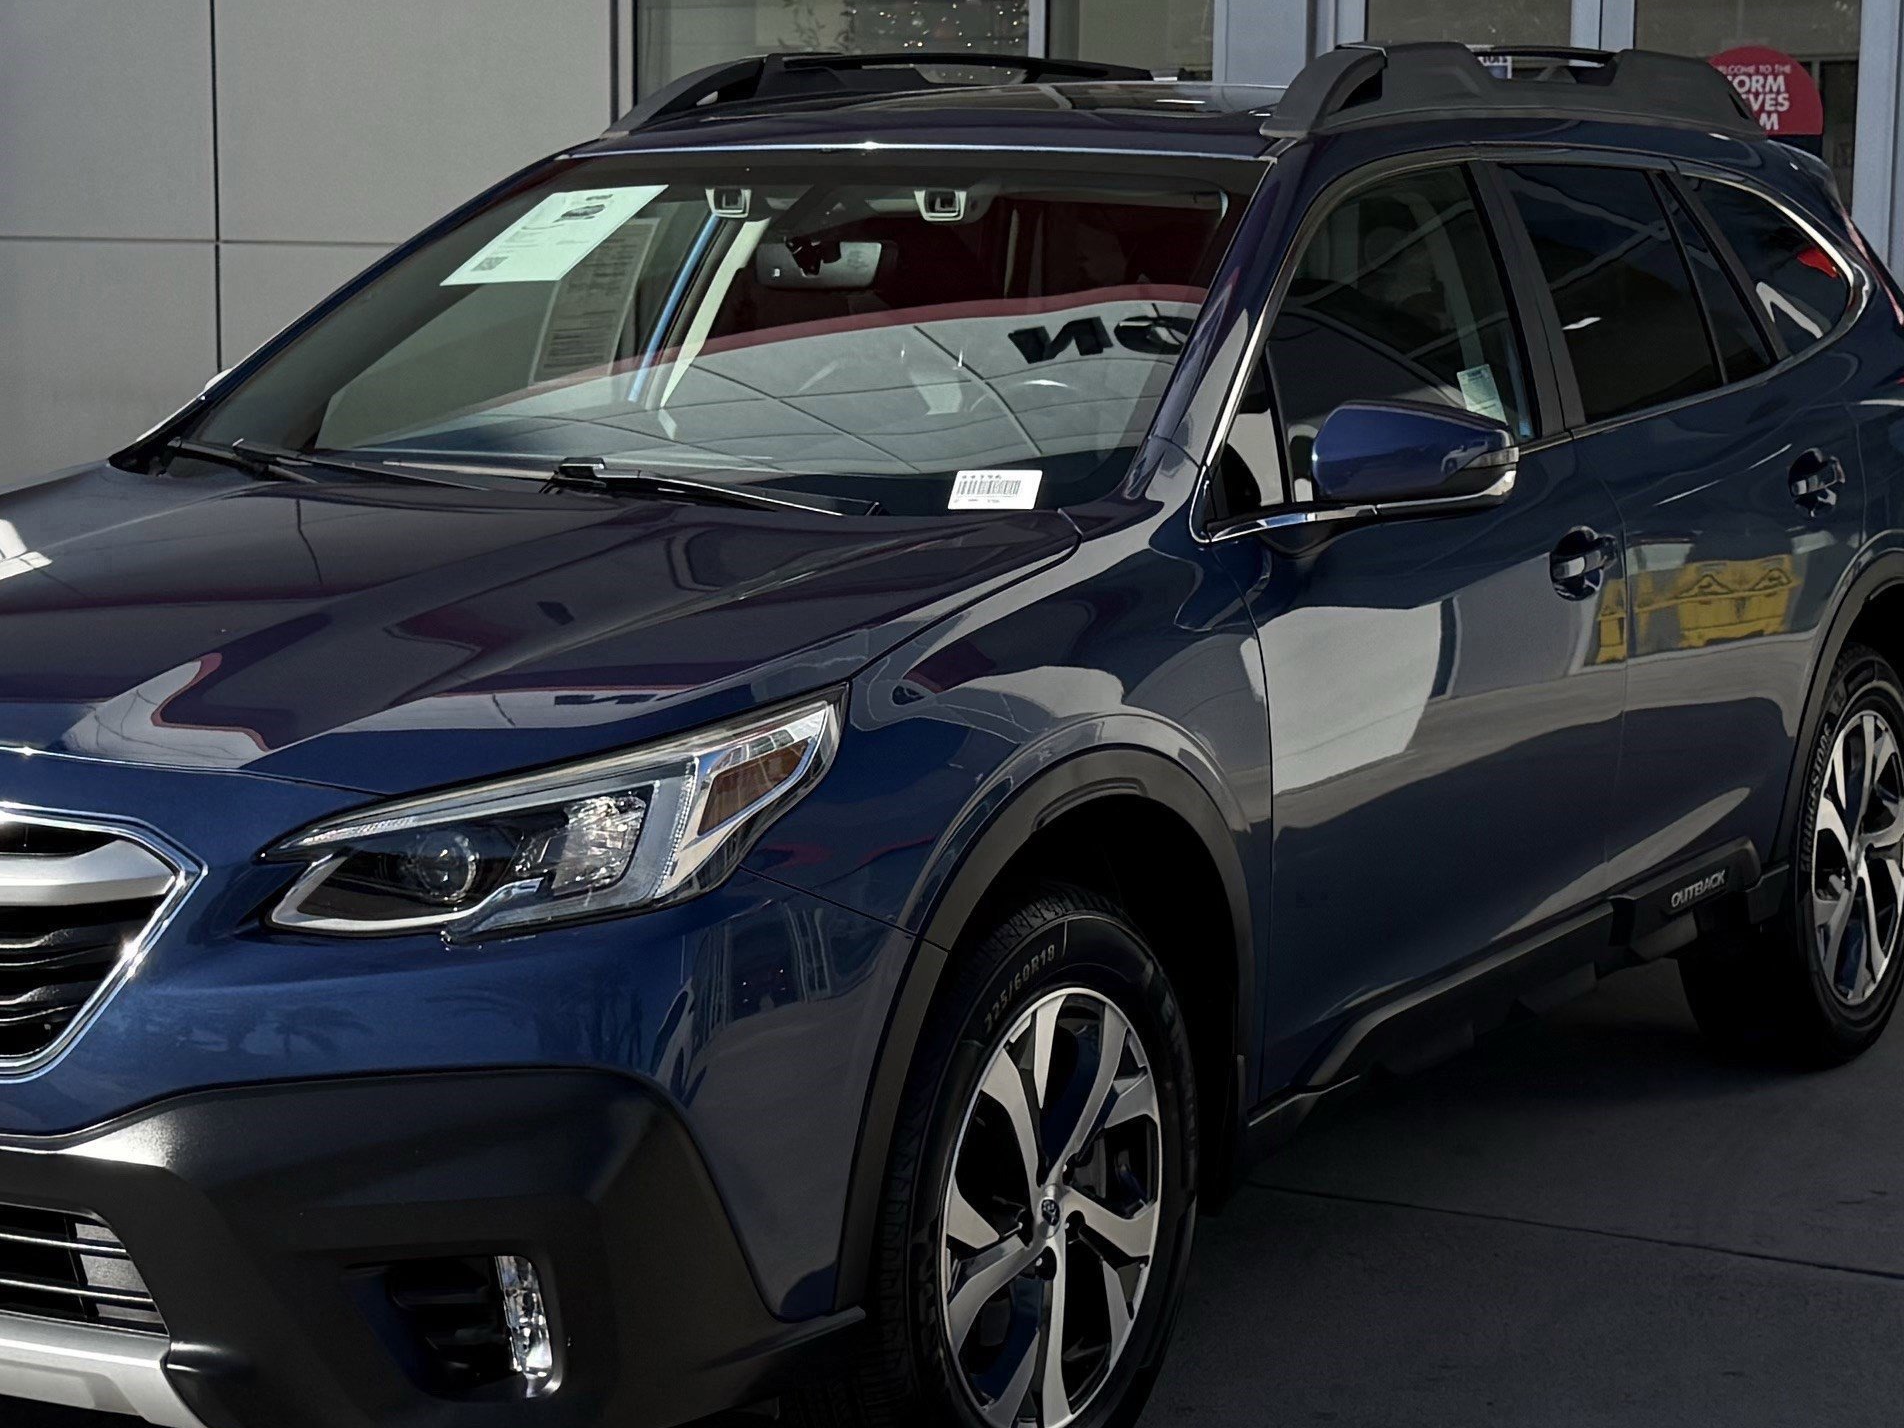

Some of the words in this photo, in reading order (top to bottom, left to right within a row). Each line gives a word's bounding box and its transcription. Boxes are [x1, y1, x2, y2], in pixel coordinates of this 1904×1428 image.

[1727, 75, 1786, 93] ORM
[1742, 93, 1790, 113] VES
[1671, 869, 1726, 908] OUTBACK
